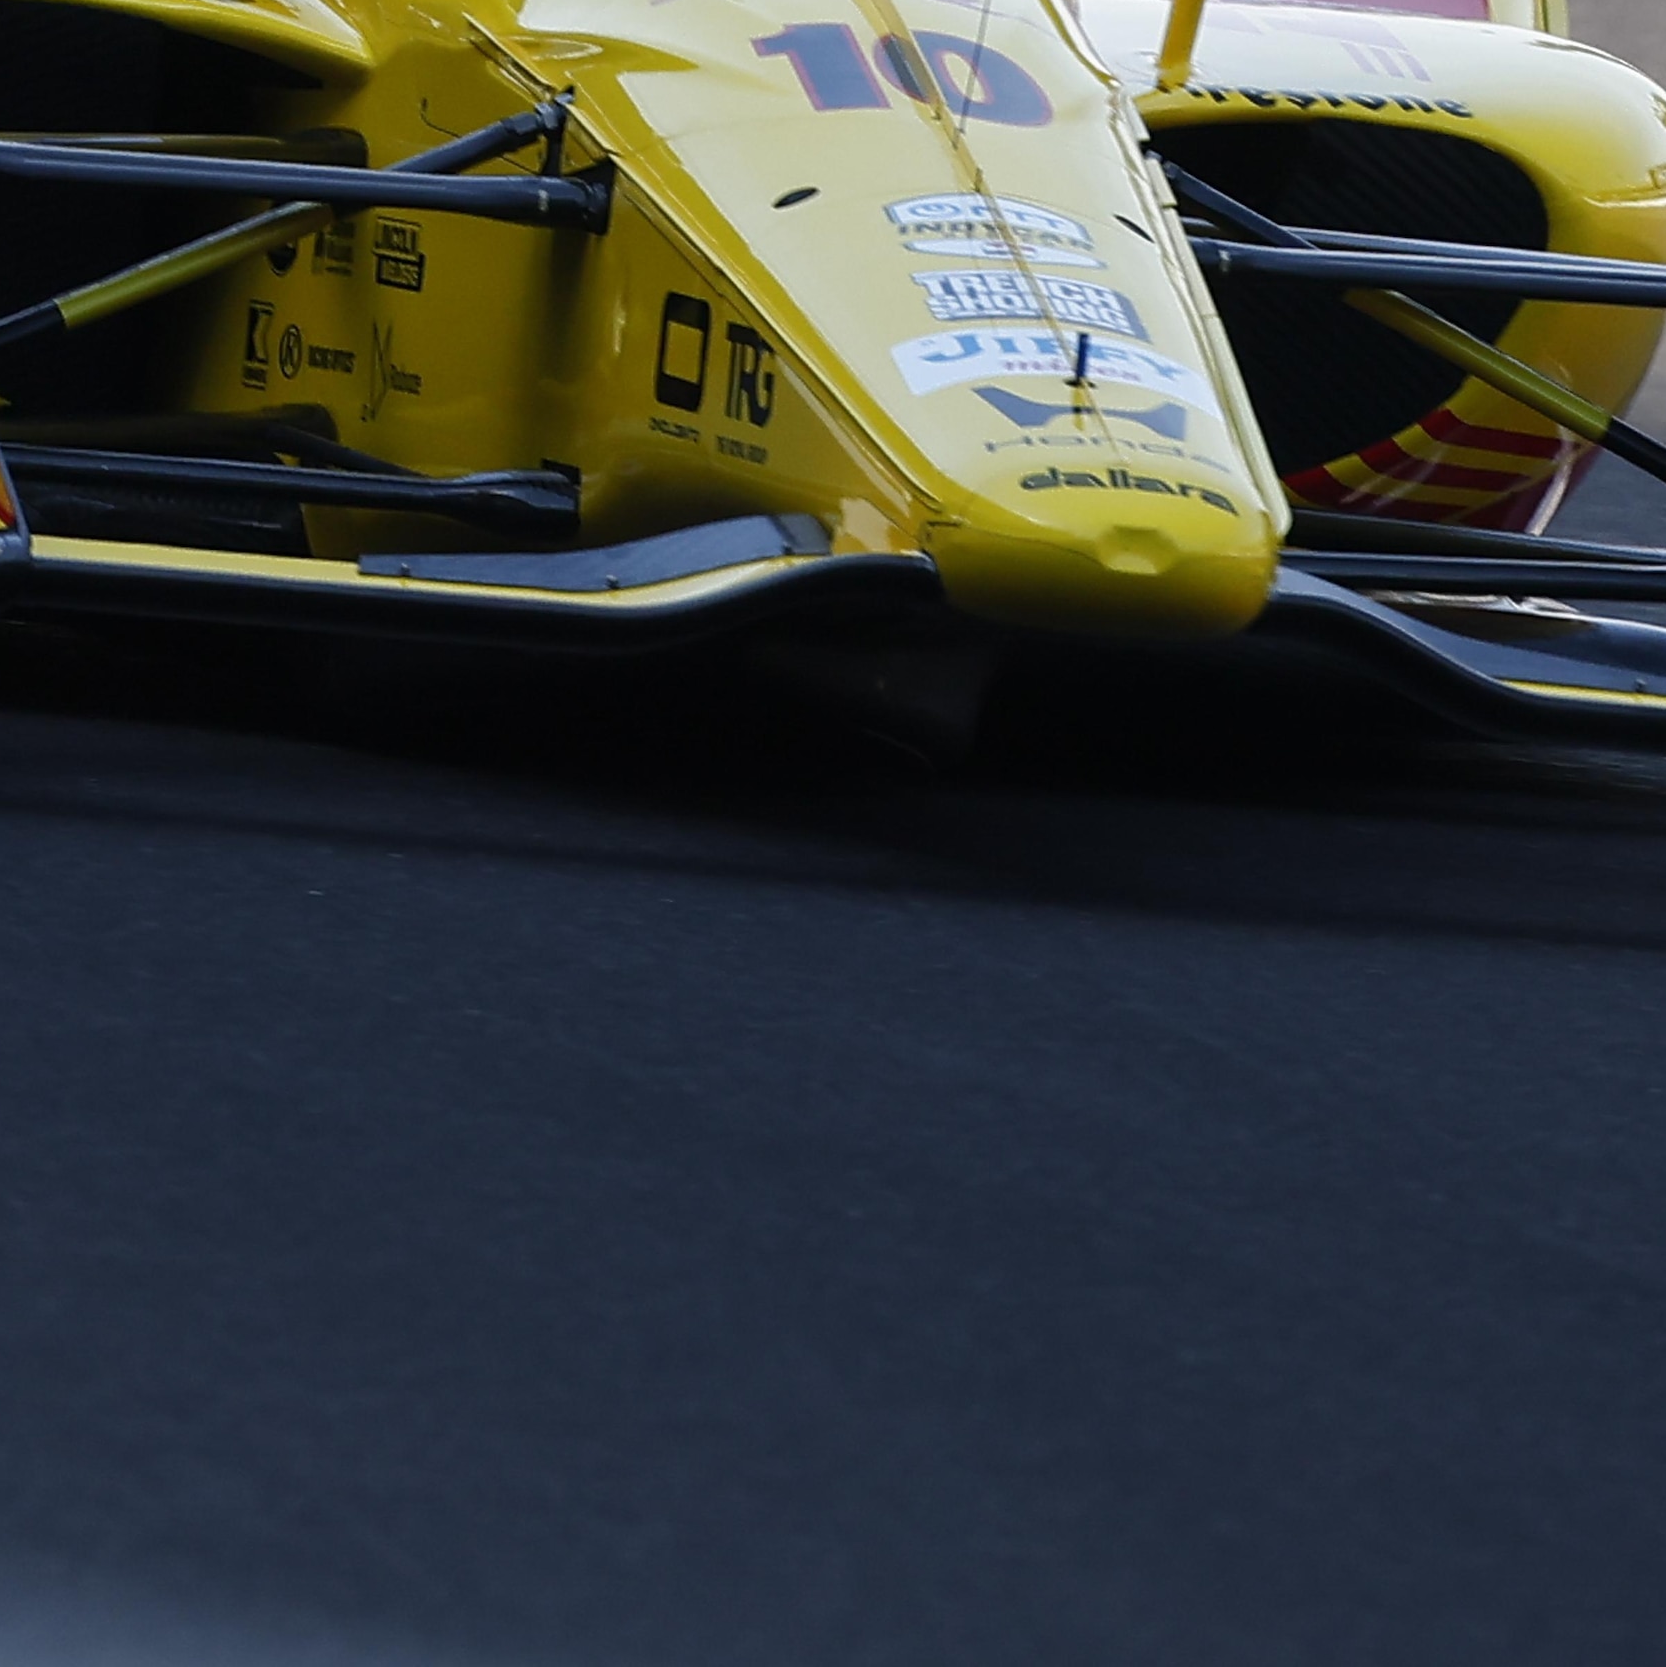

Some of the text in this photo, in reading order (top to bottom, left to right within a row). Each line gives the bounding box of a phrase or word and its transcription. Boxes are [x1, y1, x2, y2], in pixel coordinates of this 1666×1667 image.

[749, 23, 1055, 127] 10
[1184, 84, 1474, 120] irestone
[1019, 466, 1241, 517] dallara
